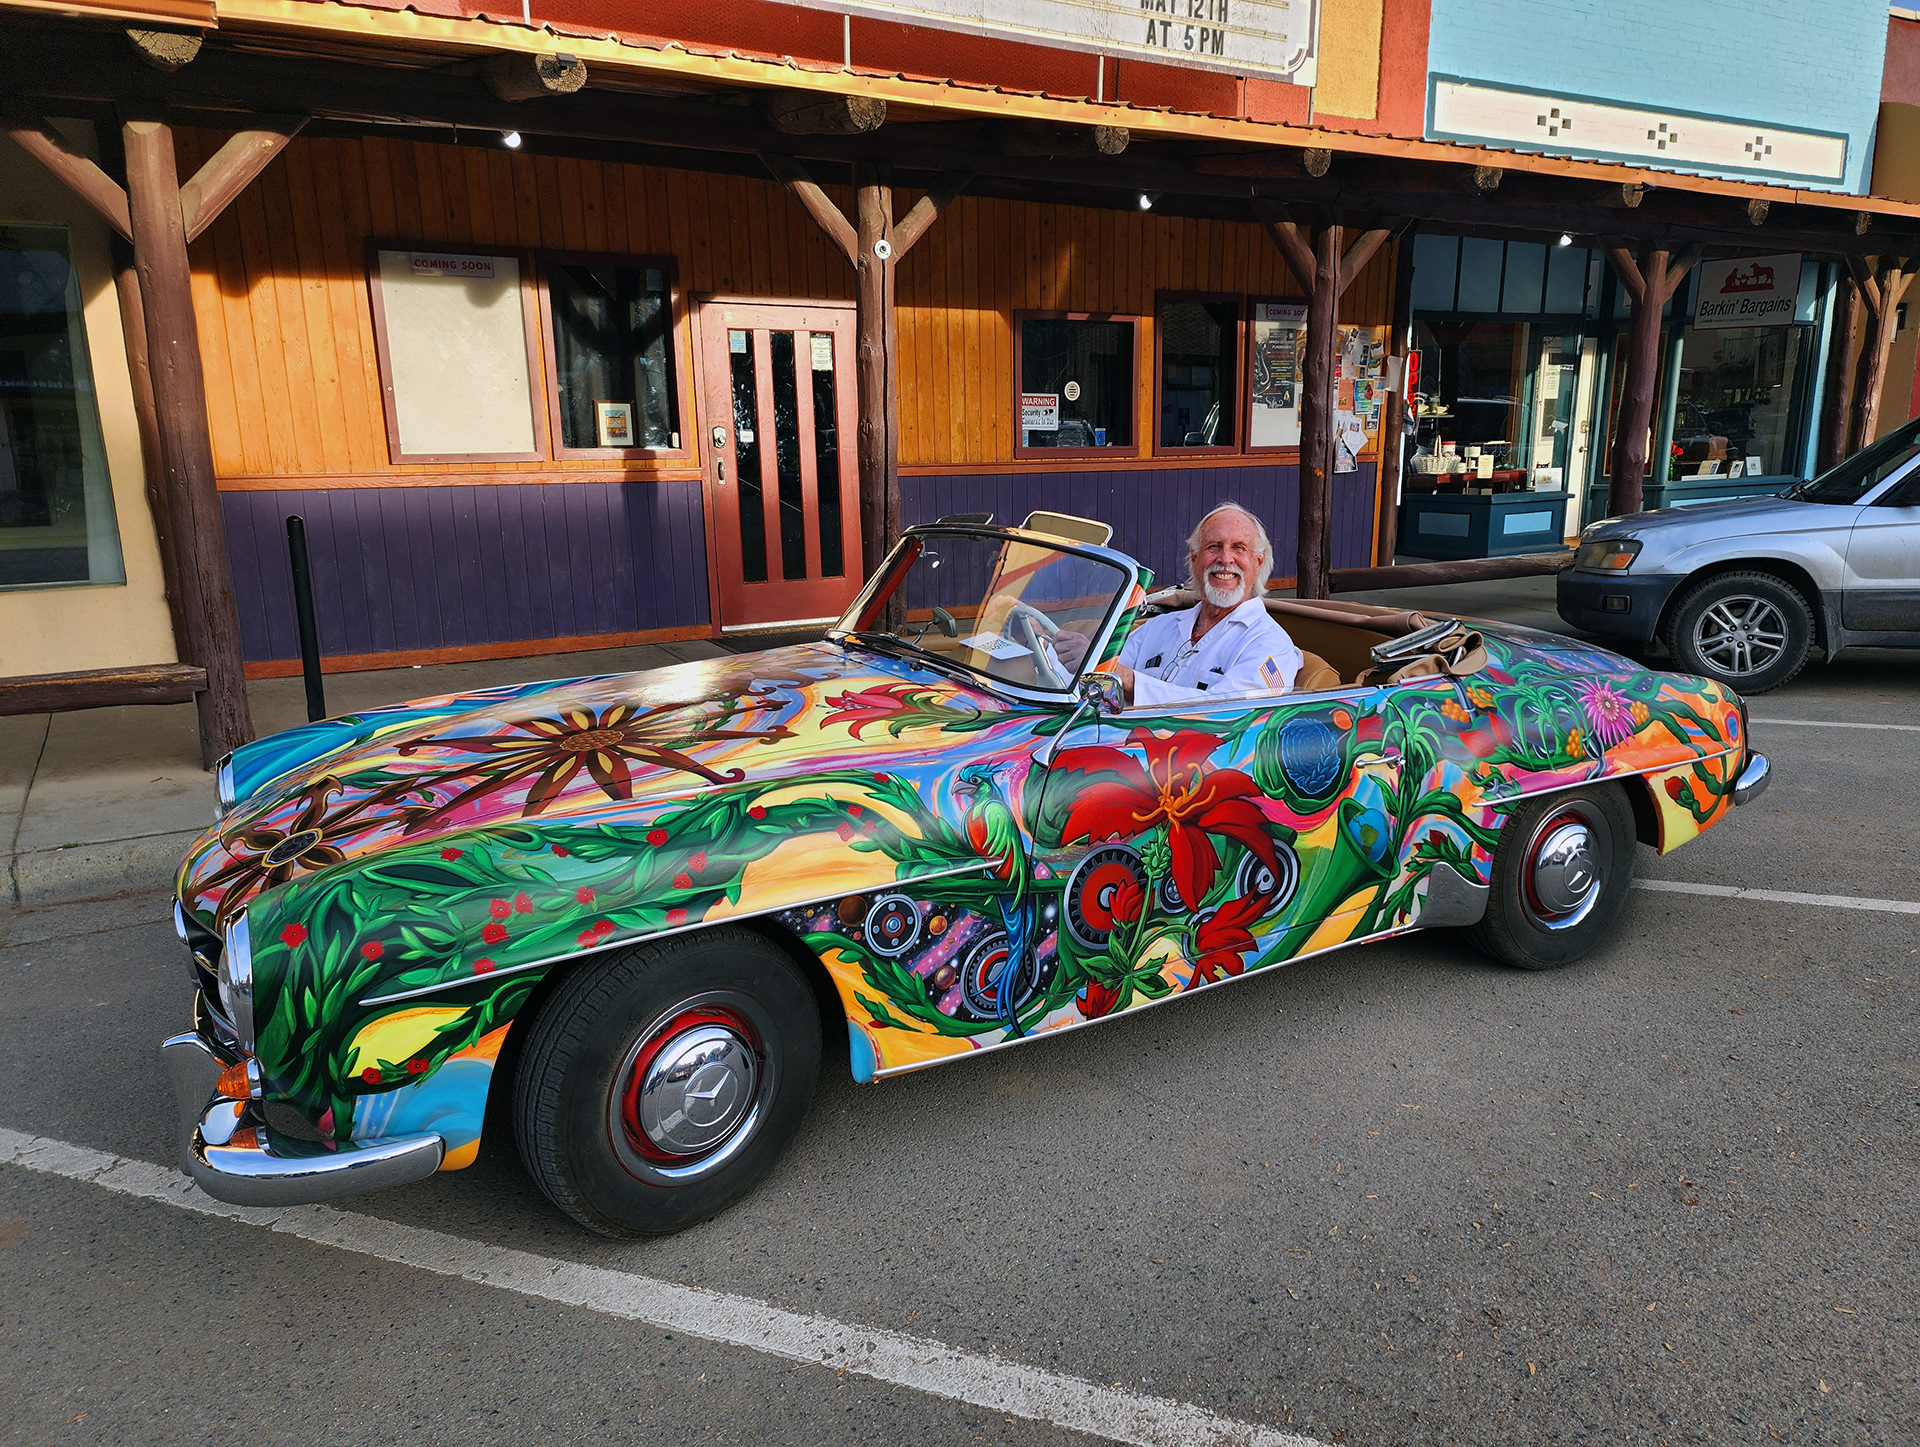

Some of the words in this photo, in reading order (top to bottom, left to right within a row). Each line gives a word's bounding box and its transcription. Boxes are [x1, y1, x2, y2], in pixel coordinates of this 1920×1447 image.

[1146, 18, 1172, 47] AT
[414, 259, 457, 270] COMING
[461, 261, 491, 271] SOON
[1700, 299, 1739, 316] Barkin'
[1740, 296, 1791, 316] Bargains
[1407, 352, 1418, 416] OPE
[1022, 397, 1055, 406] WARNING
[1022, 408, 1041, 417] Security
